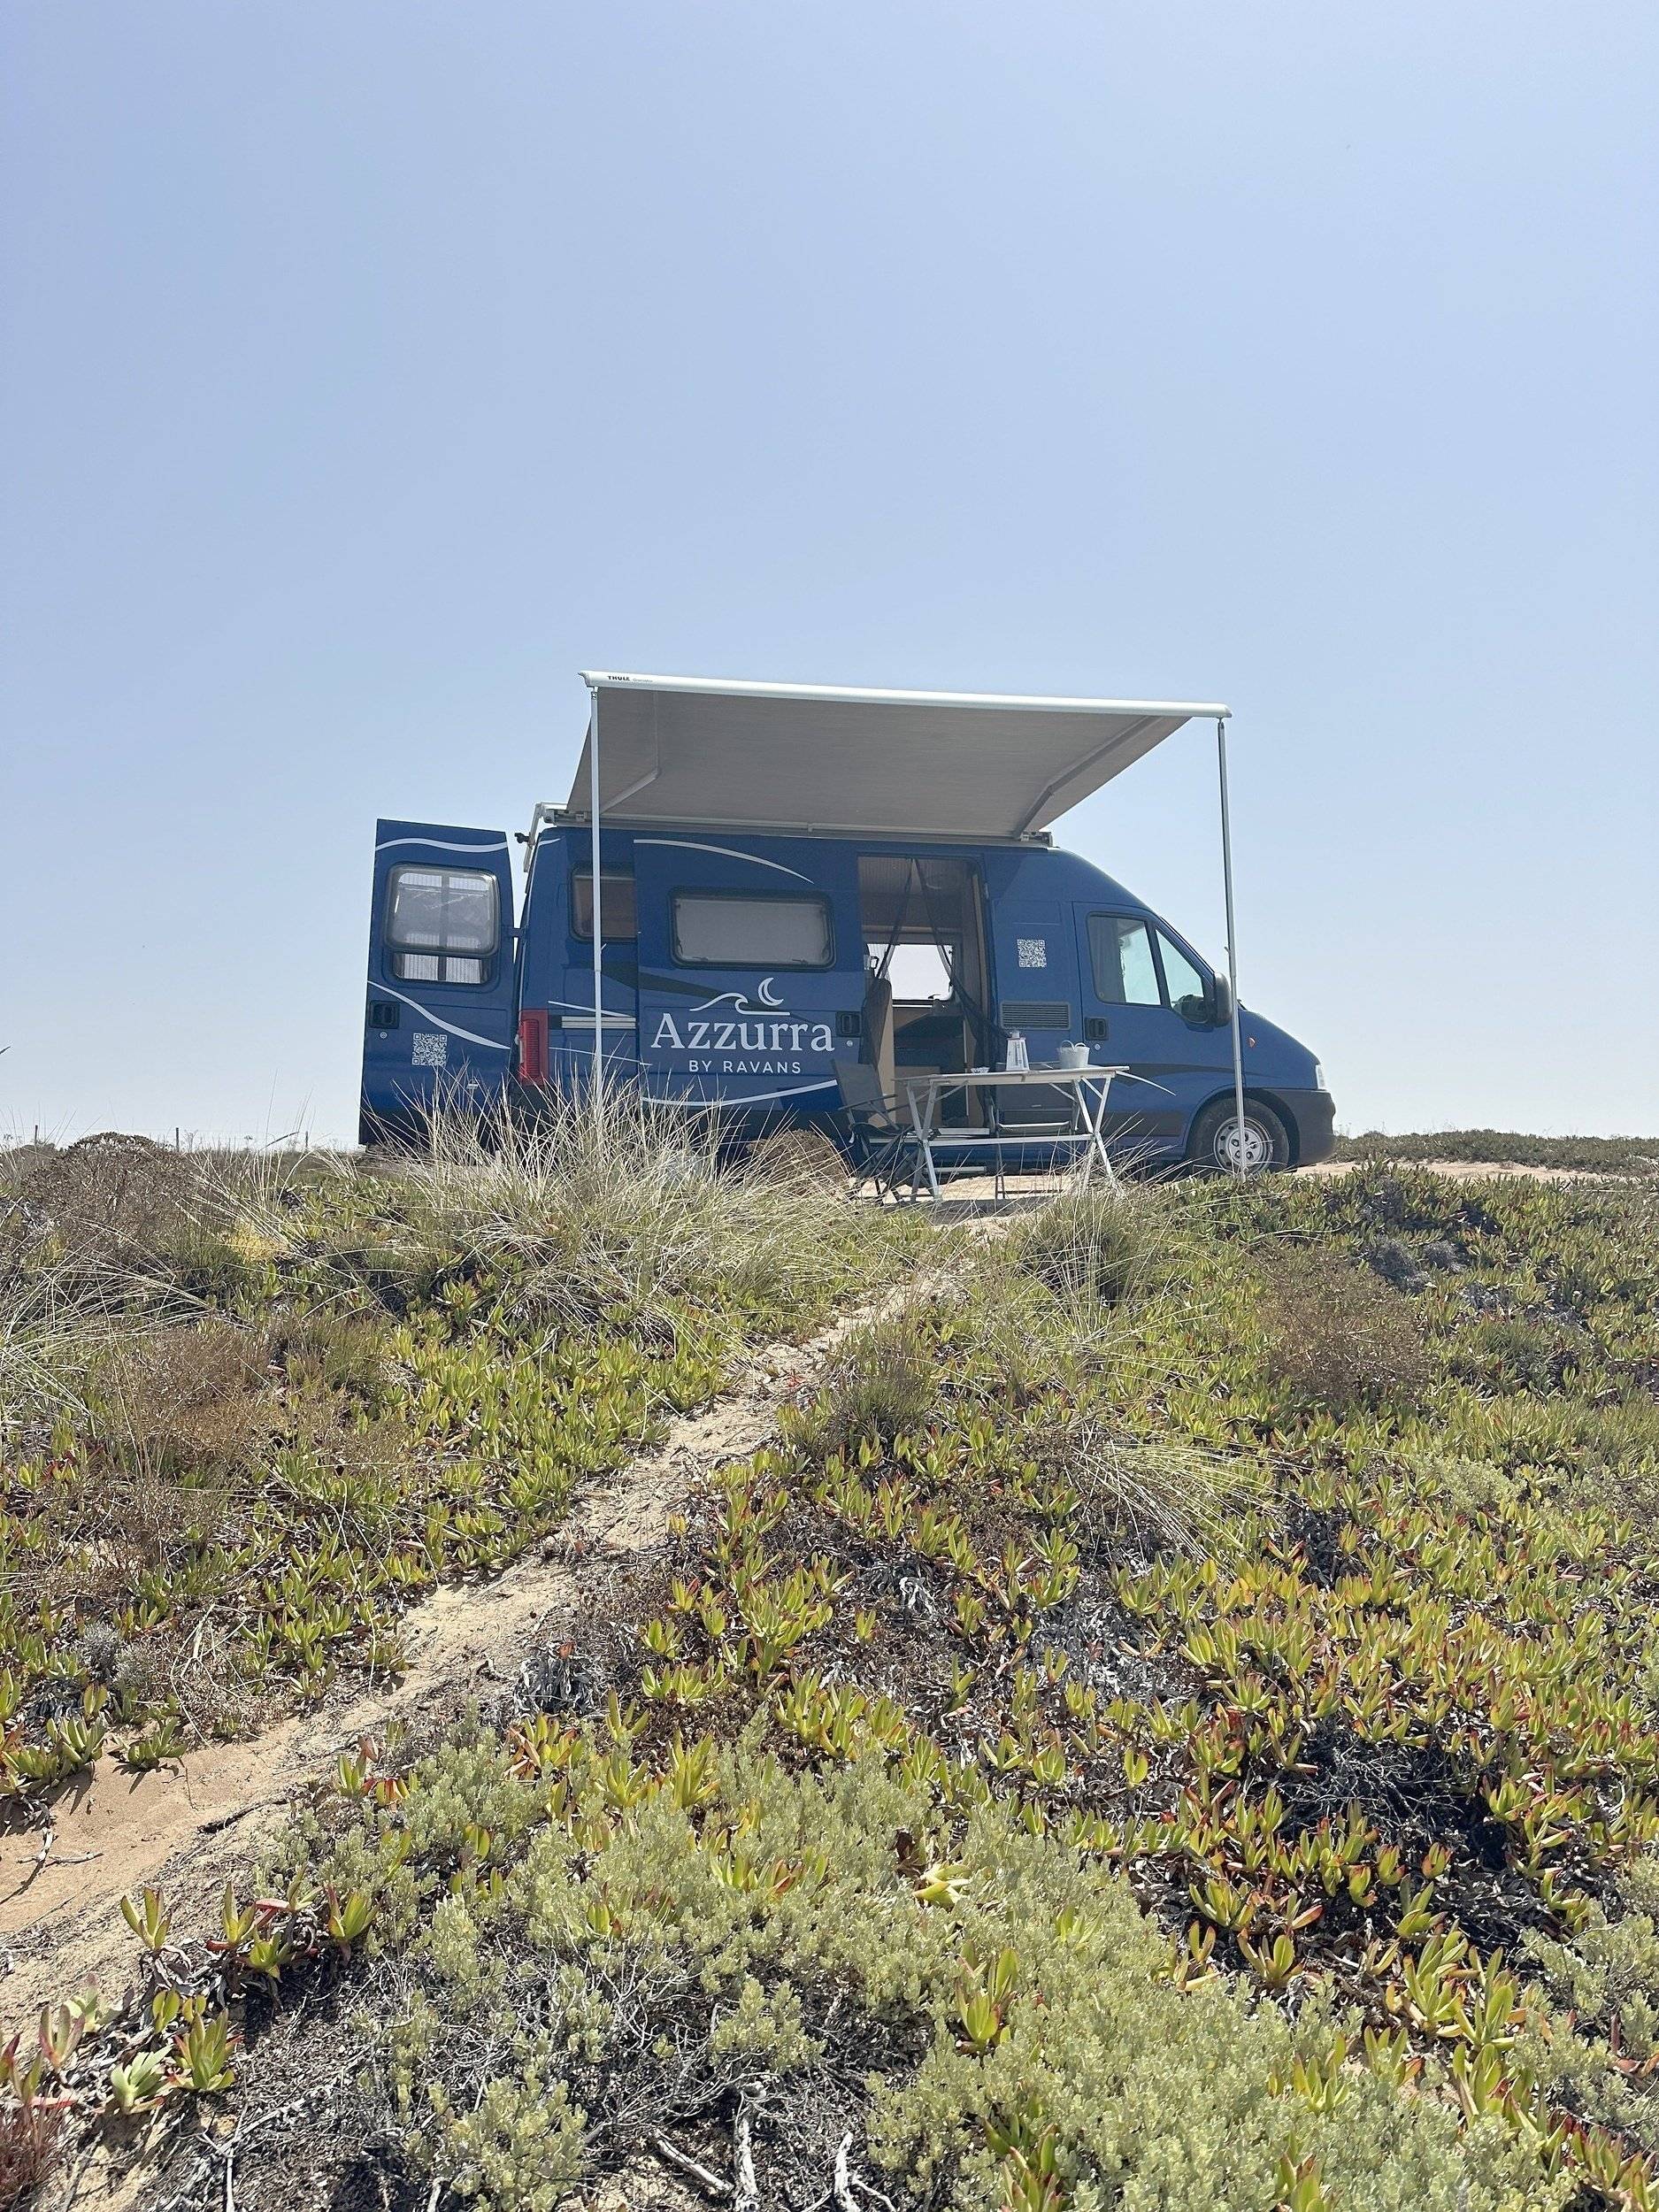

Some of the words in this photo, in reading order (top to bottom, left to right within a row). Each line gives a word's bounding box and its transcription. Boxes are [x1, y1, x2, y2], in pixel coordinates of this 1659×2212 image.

[650, 1012, 835, 1052] Azzurra
[688, 1060, 712, 1072] BY
[723, 1061, 802, 1074] RAVANS
